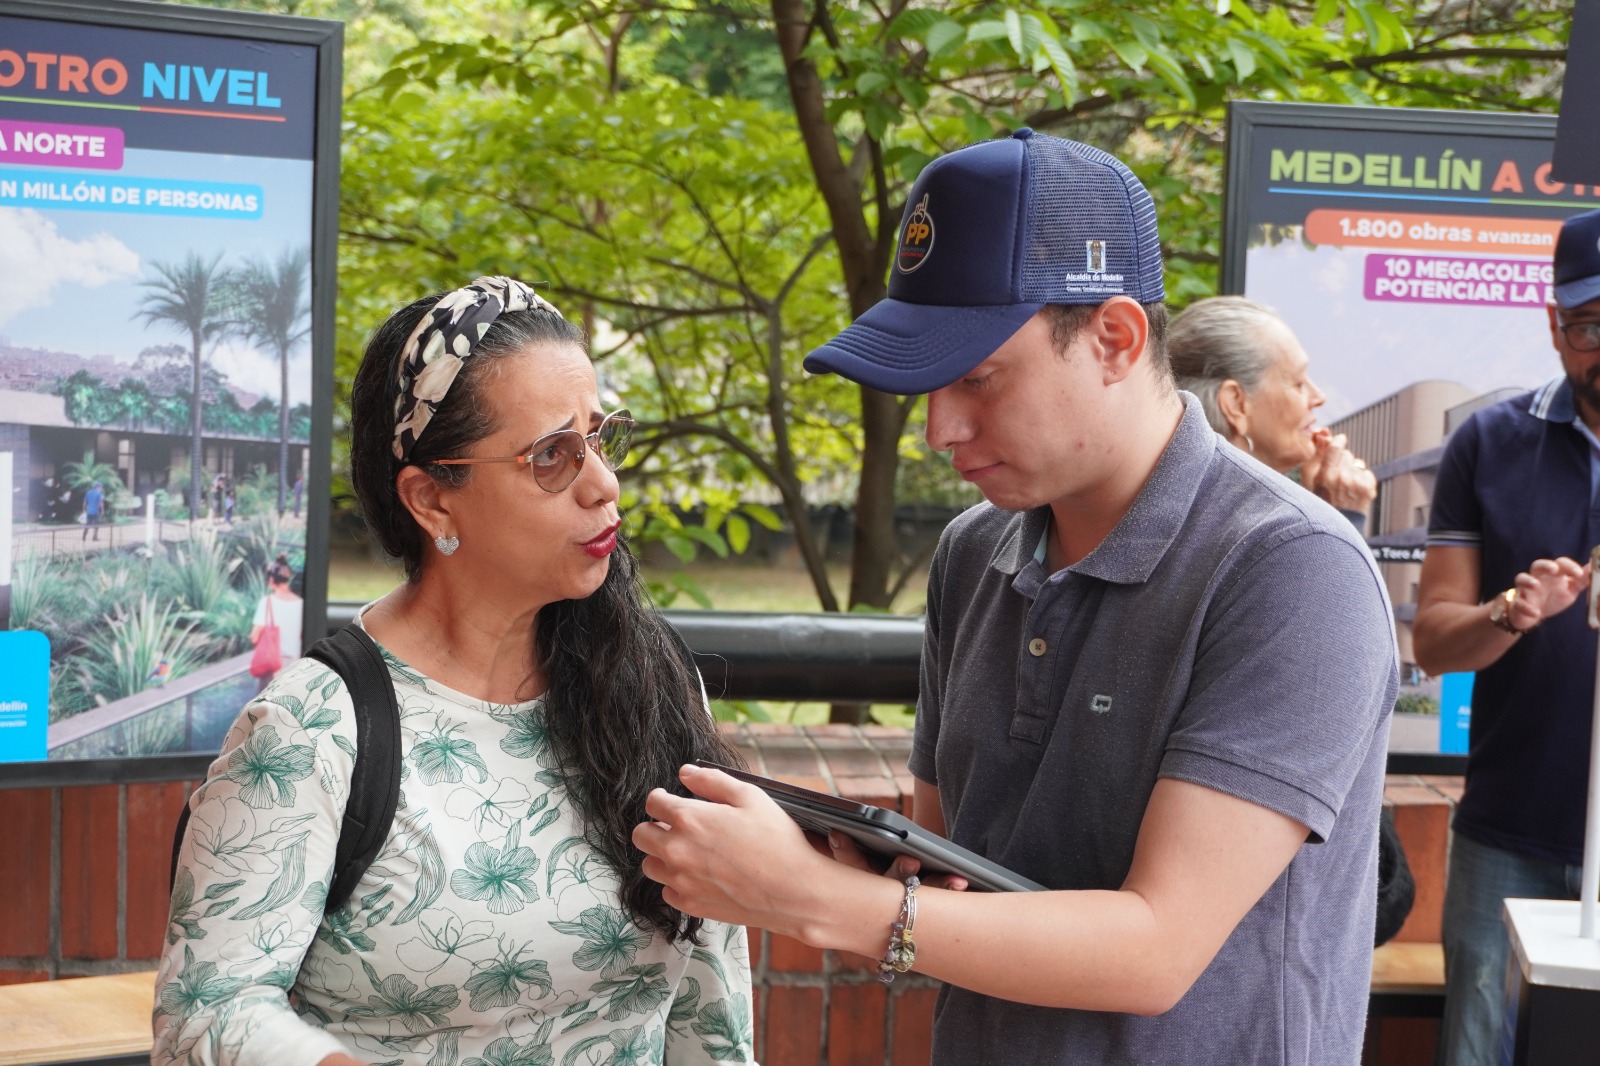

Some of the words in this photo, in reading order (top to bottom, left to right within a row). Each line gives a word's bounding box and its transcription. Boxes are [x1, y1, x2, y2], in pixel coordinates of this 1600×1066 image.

[0, 49, 129, 96] OTRO
[142, 61, 282, 108] NIVEL
[13, 130, 106, 158] NORTE
[1269, 148, 1482, 191] MEDELLÍN
[1491, 160, 1524, 194] A
[22, 179, 106, 203] MILLÓN
[111, 186, 141, 205] DE
[145, 189, 258, 212] PERSONAS
[1339, 217, 1404, 239] 1.800
[1409, 220, 1472, 243] obras
[1477, 228, 1554, 246] avanzan
[1384, 258, 1411, 278] 10
[1375, 277, 1505, 302] POTENCIAR
[1511, 284, 1539, 303] LA
